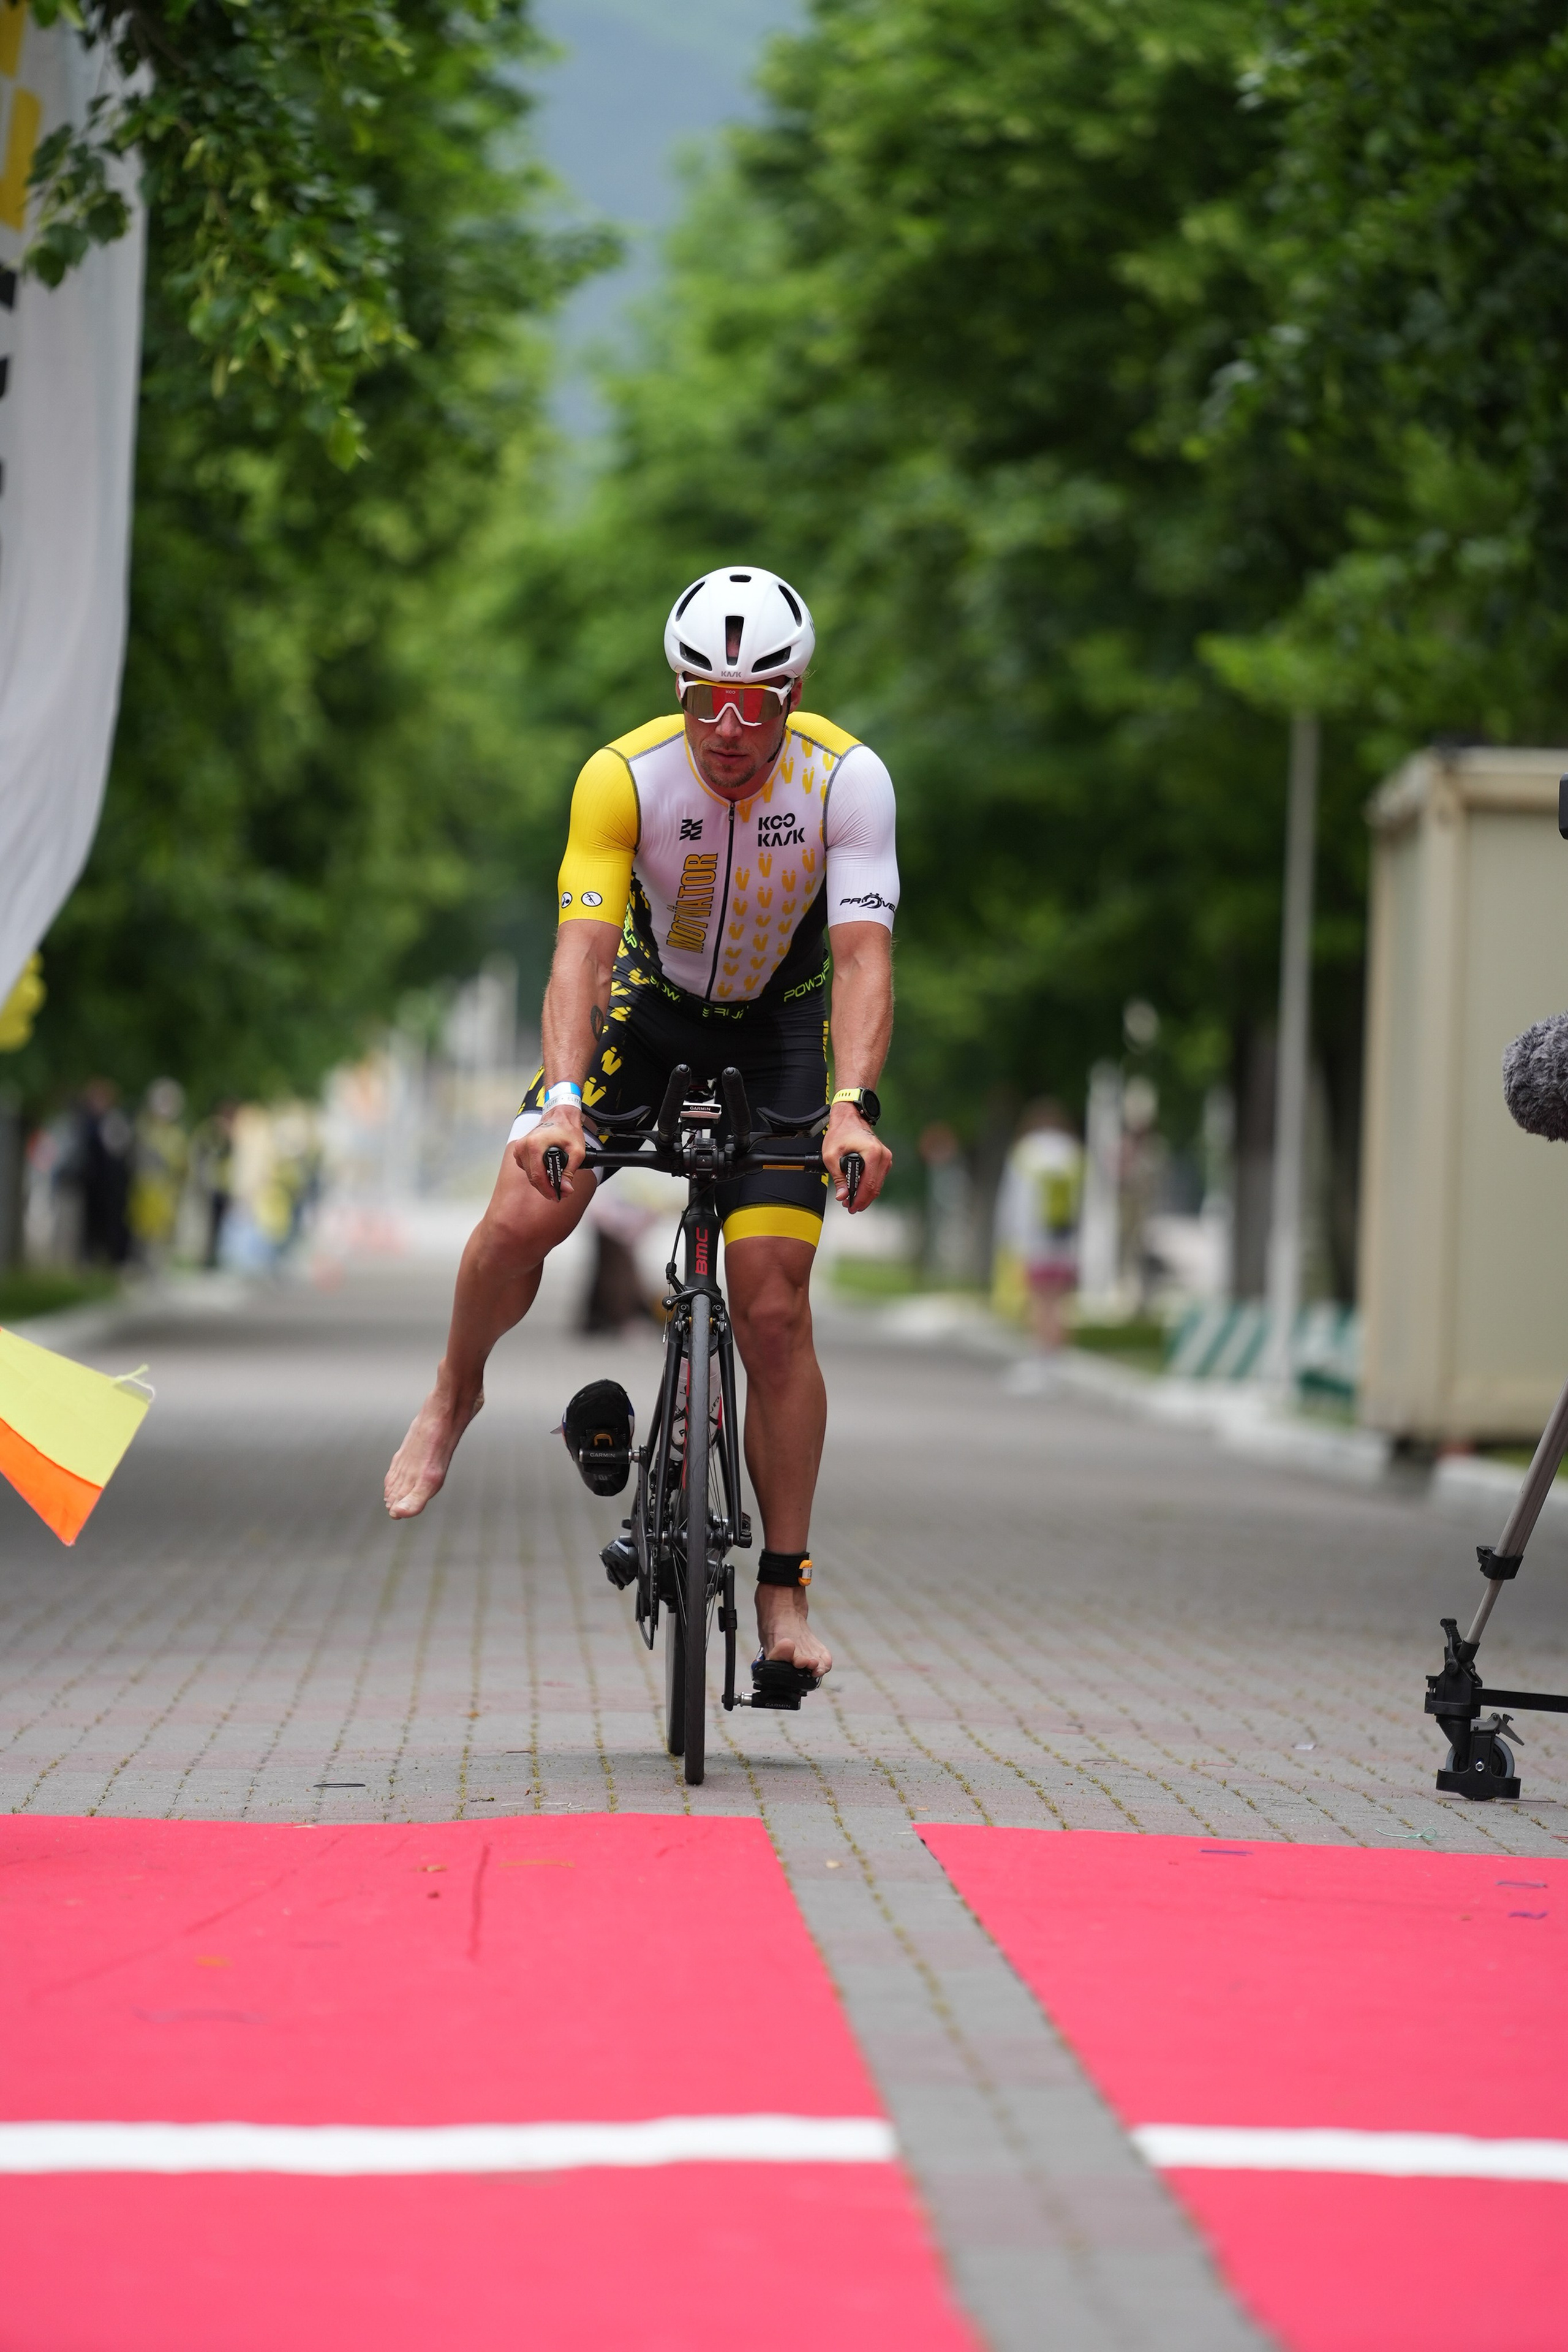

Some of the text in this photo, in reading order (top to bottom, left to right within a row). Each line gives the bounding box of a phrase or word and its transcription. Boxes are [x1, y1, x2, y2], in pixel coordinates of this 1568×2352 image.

[758, 812, 796, 831] KOO
[757, 827, 805, 847] KASK
[695, 1226, 708, 1276] BMC
